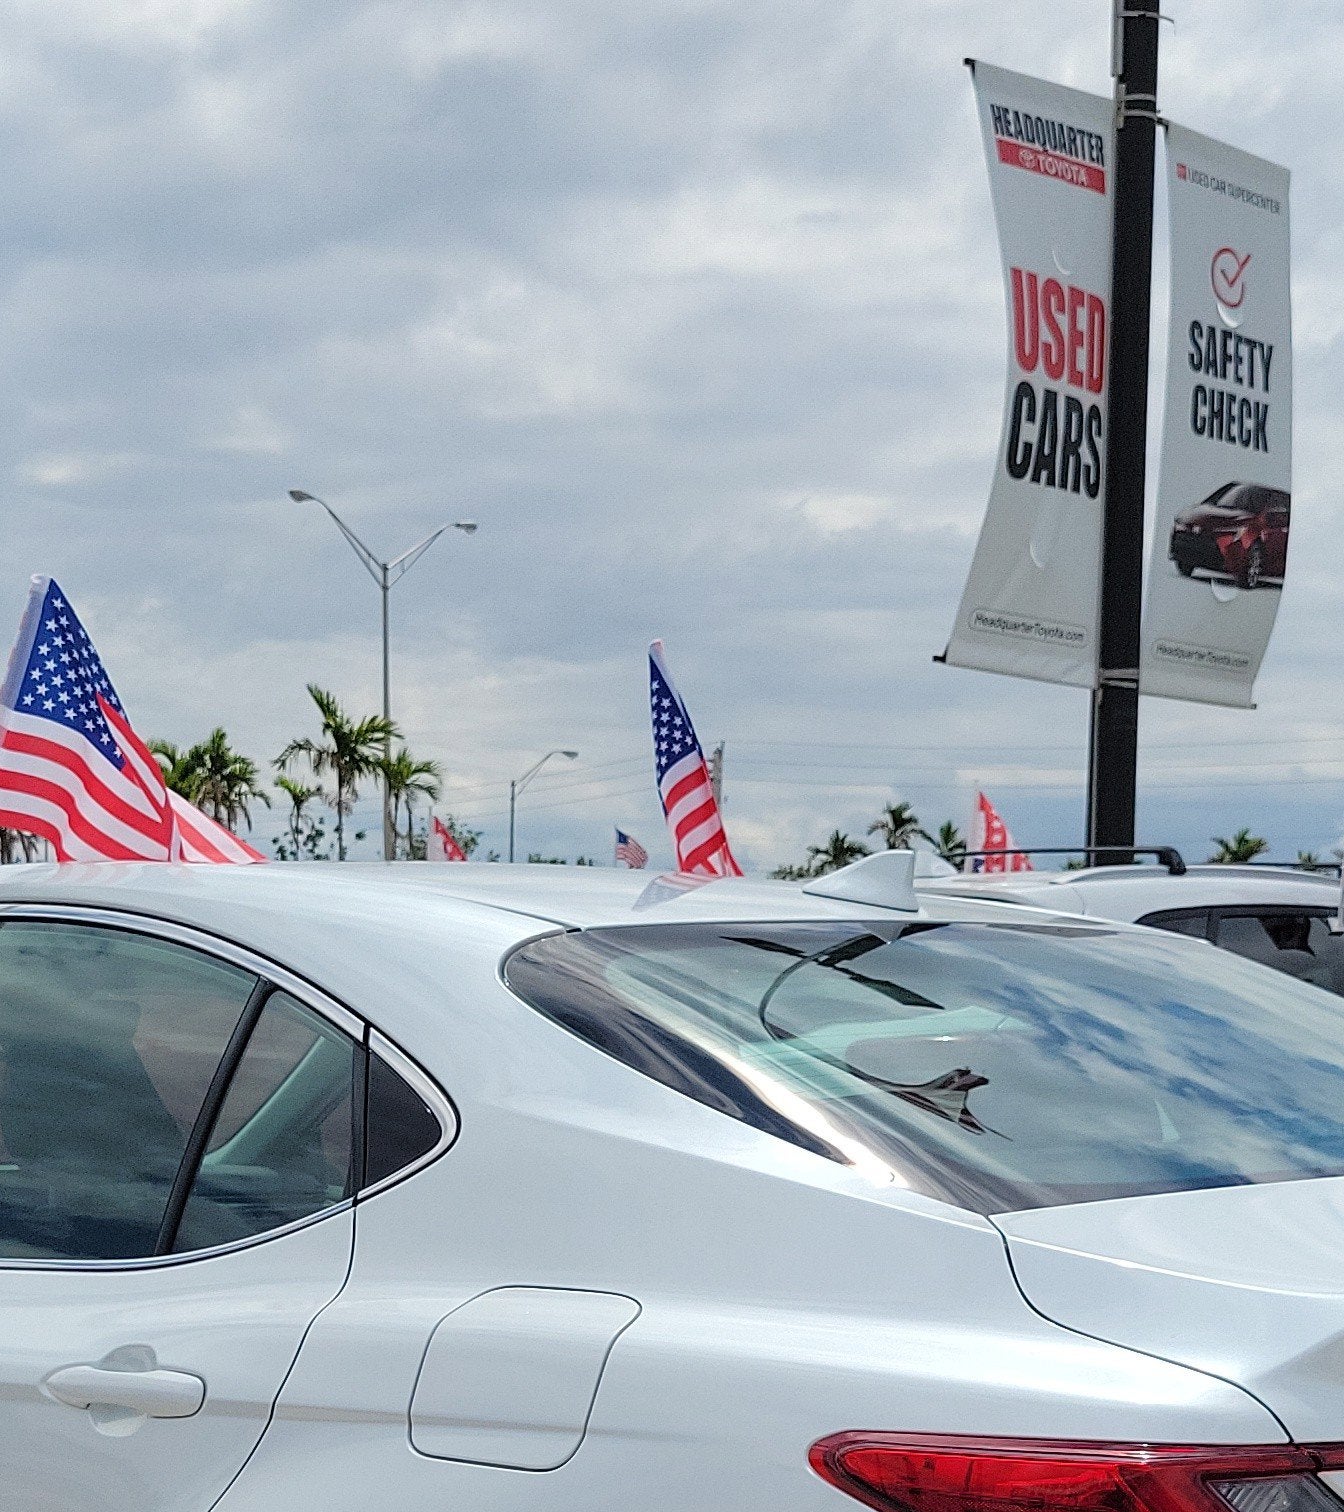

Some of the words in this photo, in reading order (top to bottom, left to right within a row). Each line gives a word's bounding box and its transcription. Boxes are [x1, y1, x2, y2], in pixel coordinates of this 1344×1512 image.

[990, 104, 1104, 167] HEADQUARTER
[1036, 154, 1087, 186] TOYOTA
[1010, 267, 1105, 394] USED
[1188, 320, 1274, 393] SAFETY
[1007, 381, 1102, 499] CARS
[1190, 383, 1269, 453] CHECK
